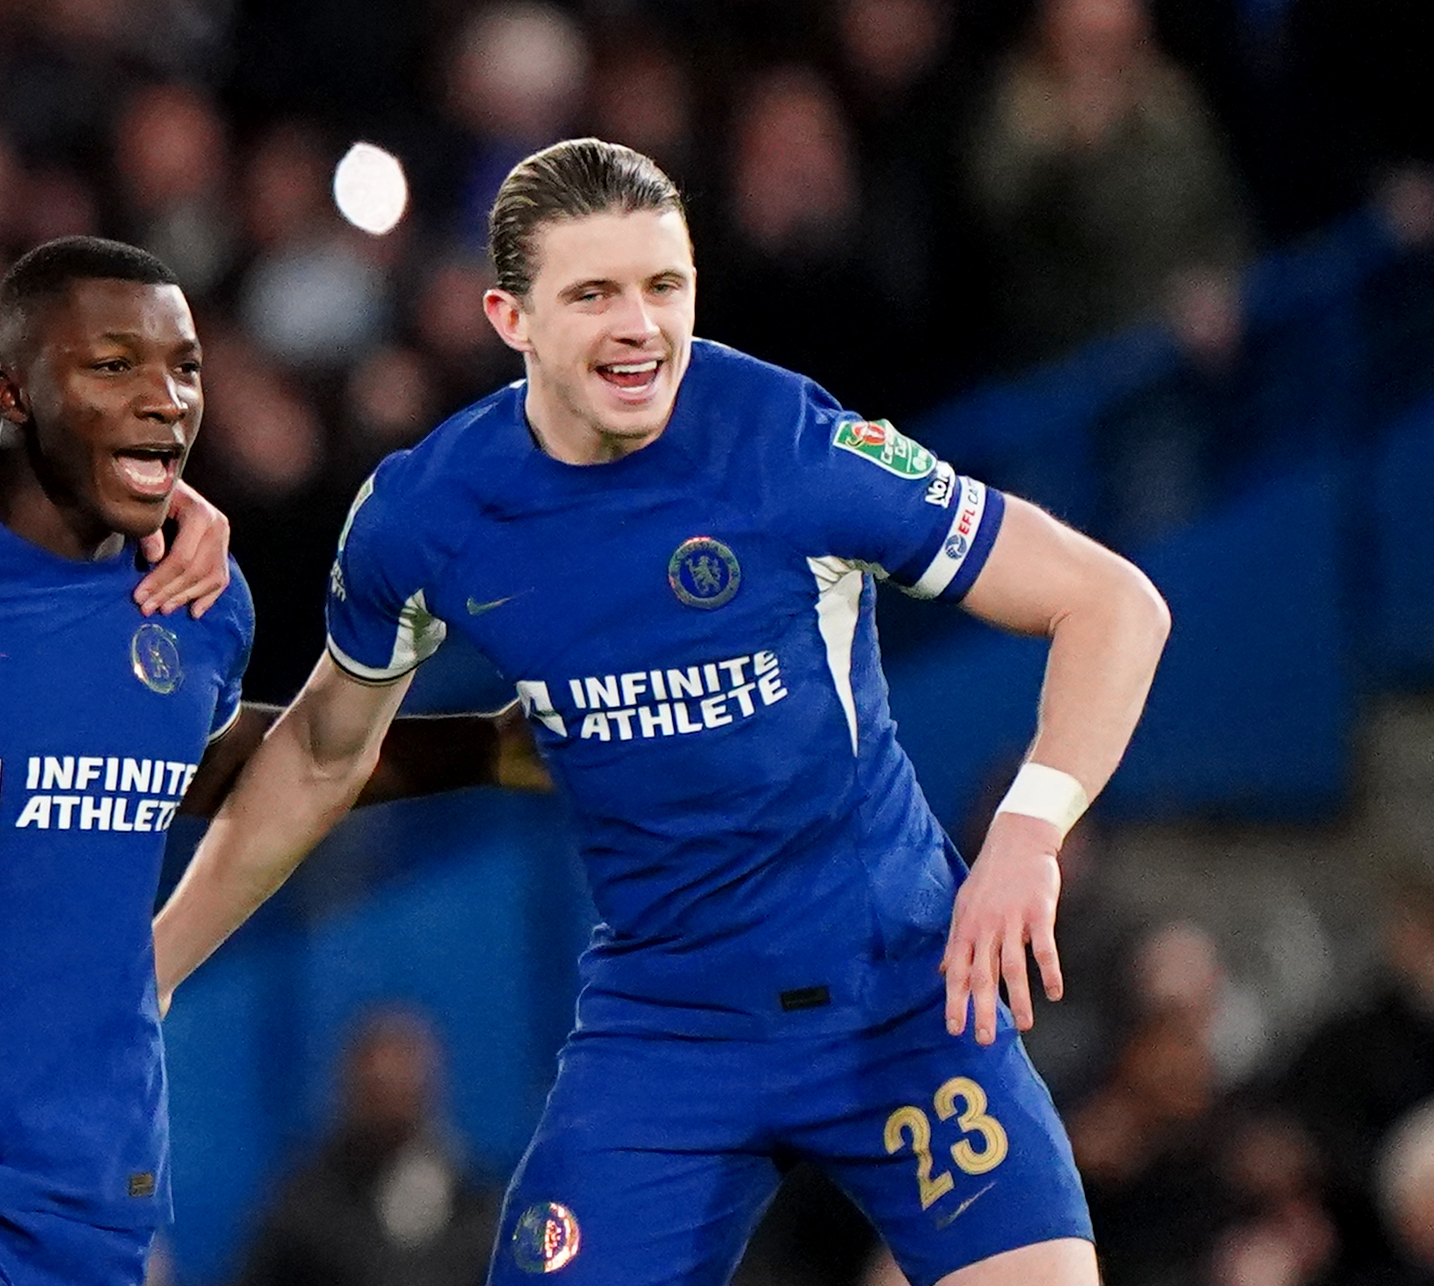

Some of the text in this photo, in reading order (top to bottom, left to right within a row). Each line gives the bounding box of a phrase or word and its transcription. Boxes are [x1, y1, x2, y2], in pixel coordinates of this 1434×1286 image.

[959, 508, 976, 536] EFL
[569, 649, 779, 710] INFINITE
[580, 667, 789, 742] ATHLETE
[15, 795, 181, 832] ATHLET
[884, 1076, 1009, 1212] 23
